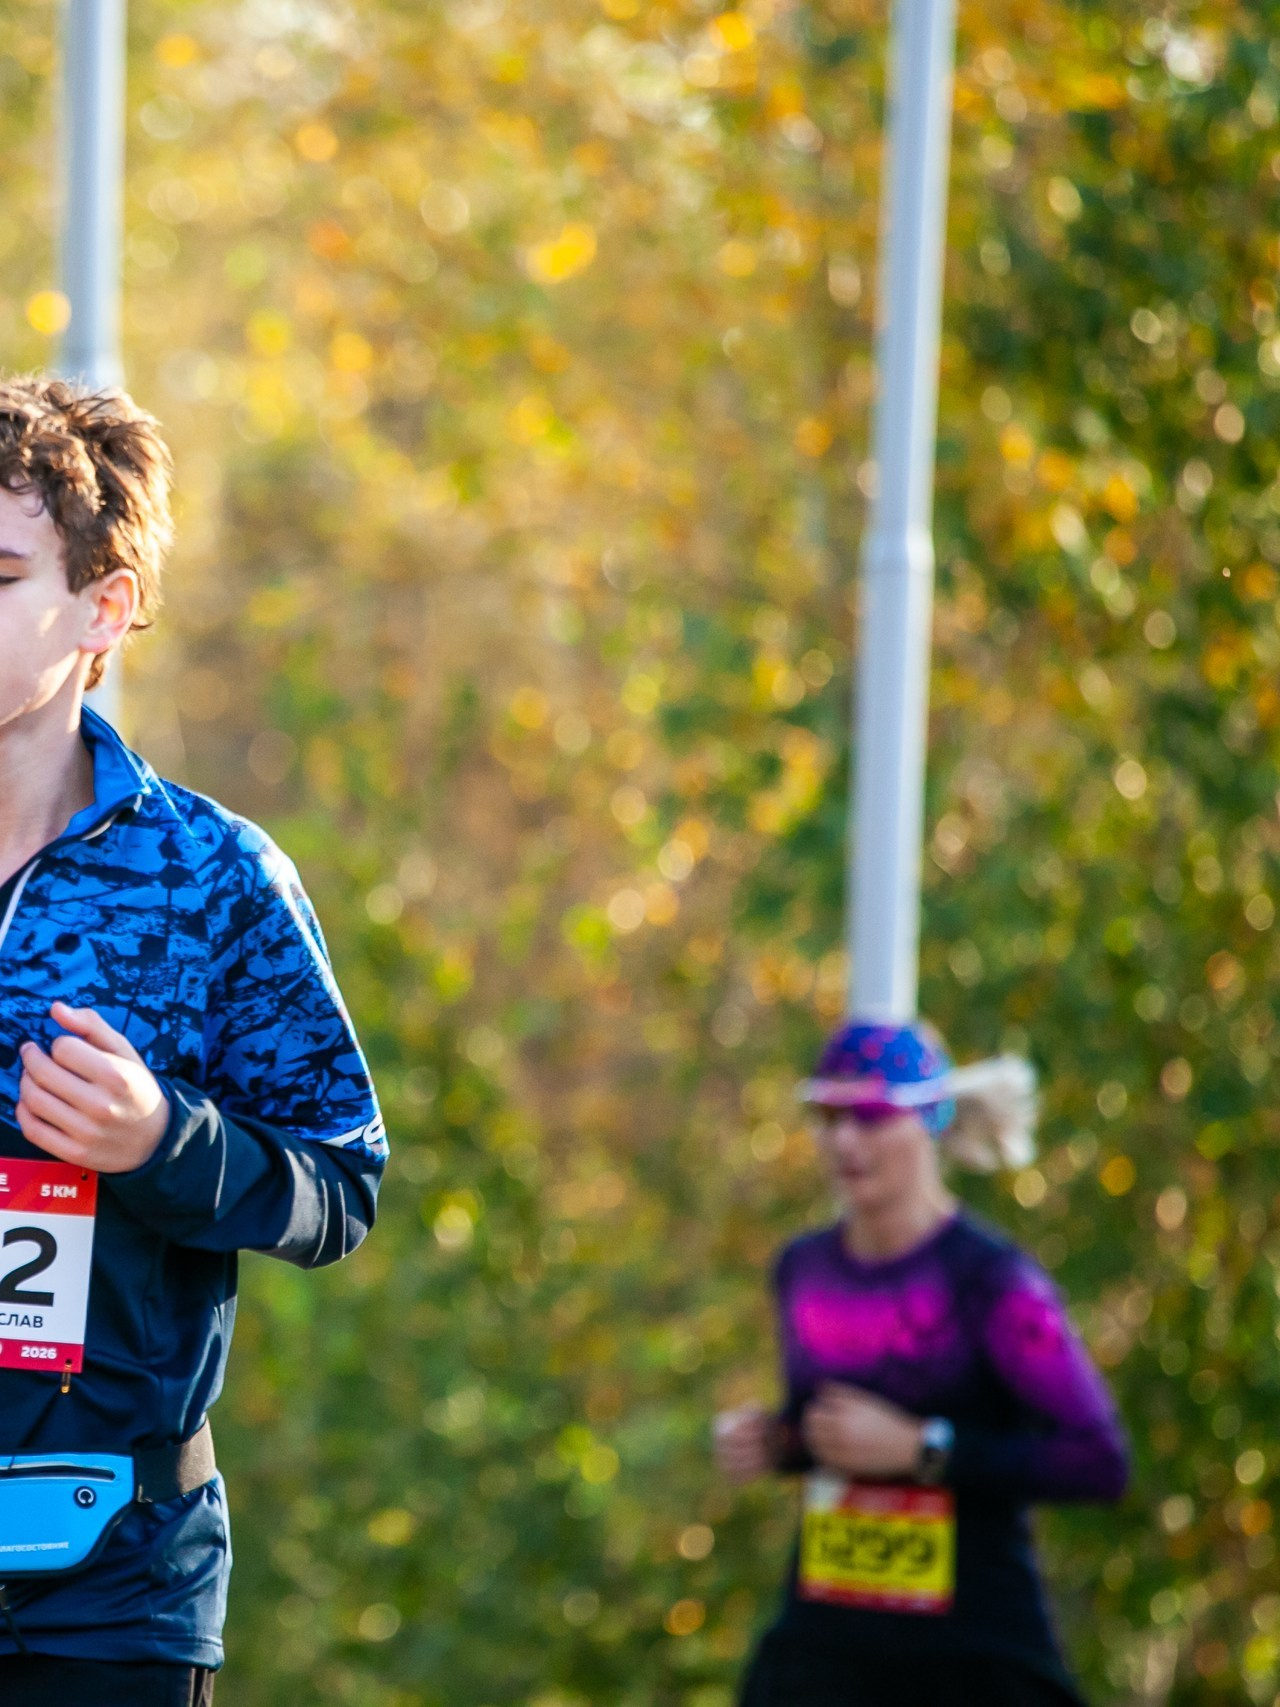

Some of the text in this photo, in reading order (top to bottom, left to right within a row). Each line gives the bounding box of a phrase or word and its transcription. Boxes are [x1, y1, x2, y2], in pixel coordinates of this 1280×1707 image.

[40, 1184, 78, 1199] 5 КМ
[20, 1346, 58, 1360] 2026
